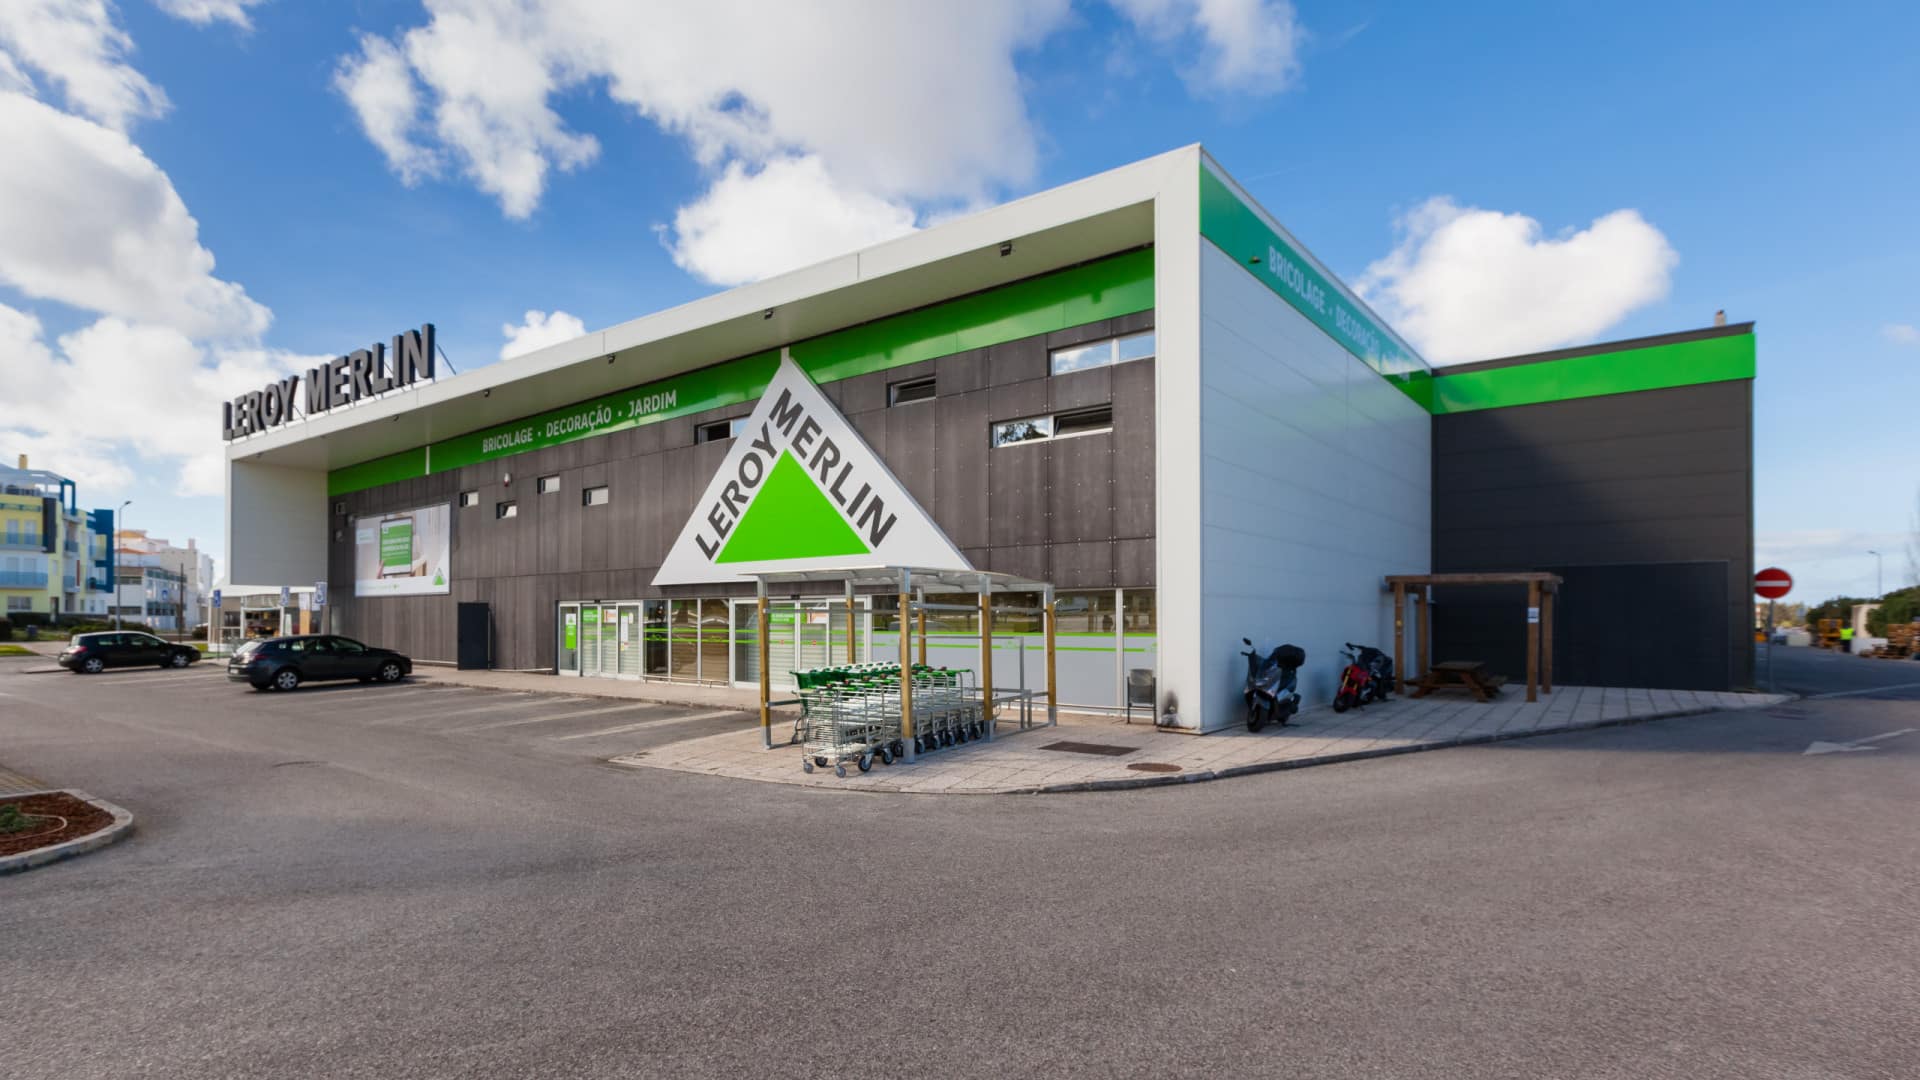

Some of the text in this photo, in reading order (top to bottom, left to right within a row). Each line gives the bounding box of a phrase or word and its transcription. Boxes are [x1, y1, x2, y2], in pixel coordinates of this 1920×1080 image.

[1269, 246, 1325, 315] BRICOLAGE
[222, 323, 435, 440] LEROY MERLIN
[482, 390, 677, 453] BRICOLAGE DECORAÇÃO JARDIM
[695, 387, 898, 561] LEROY MERLIN
